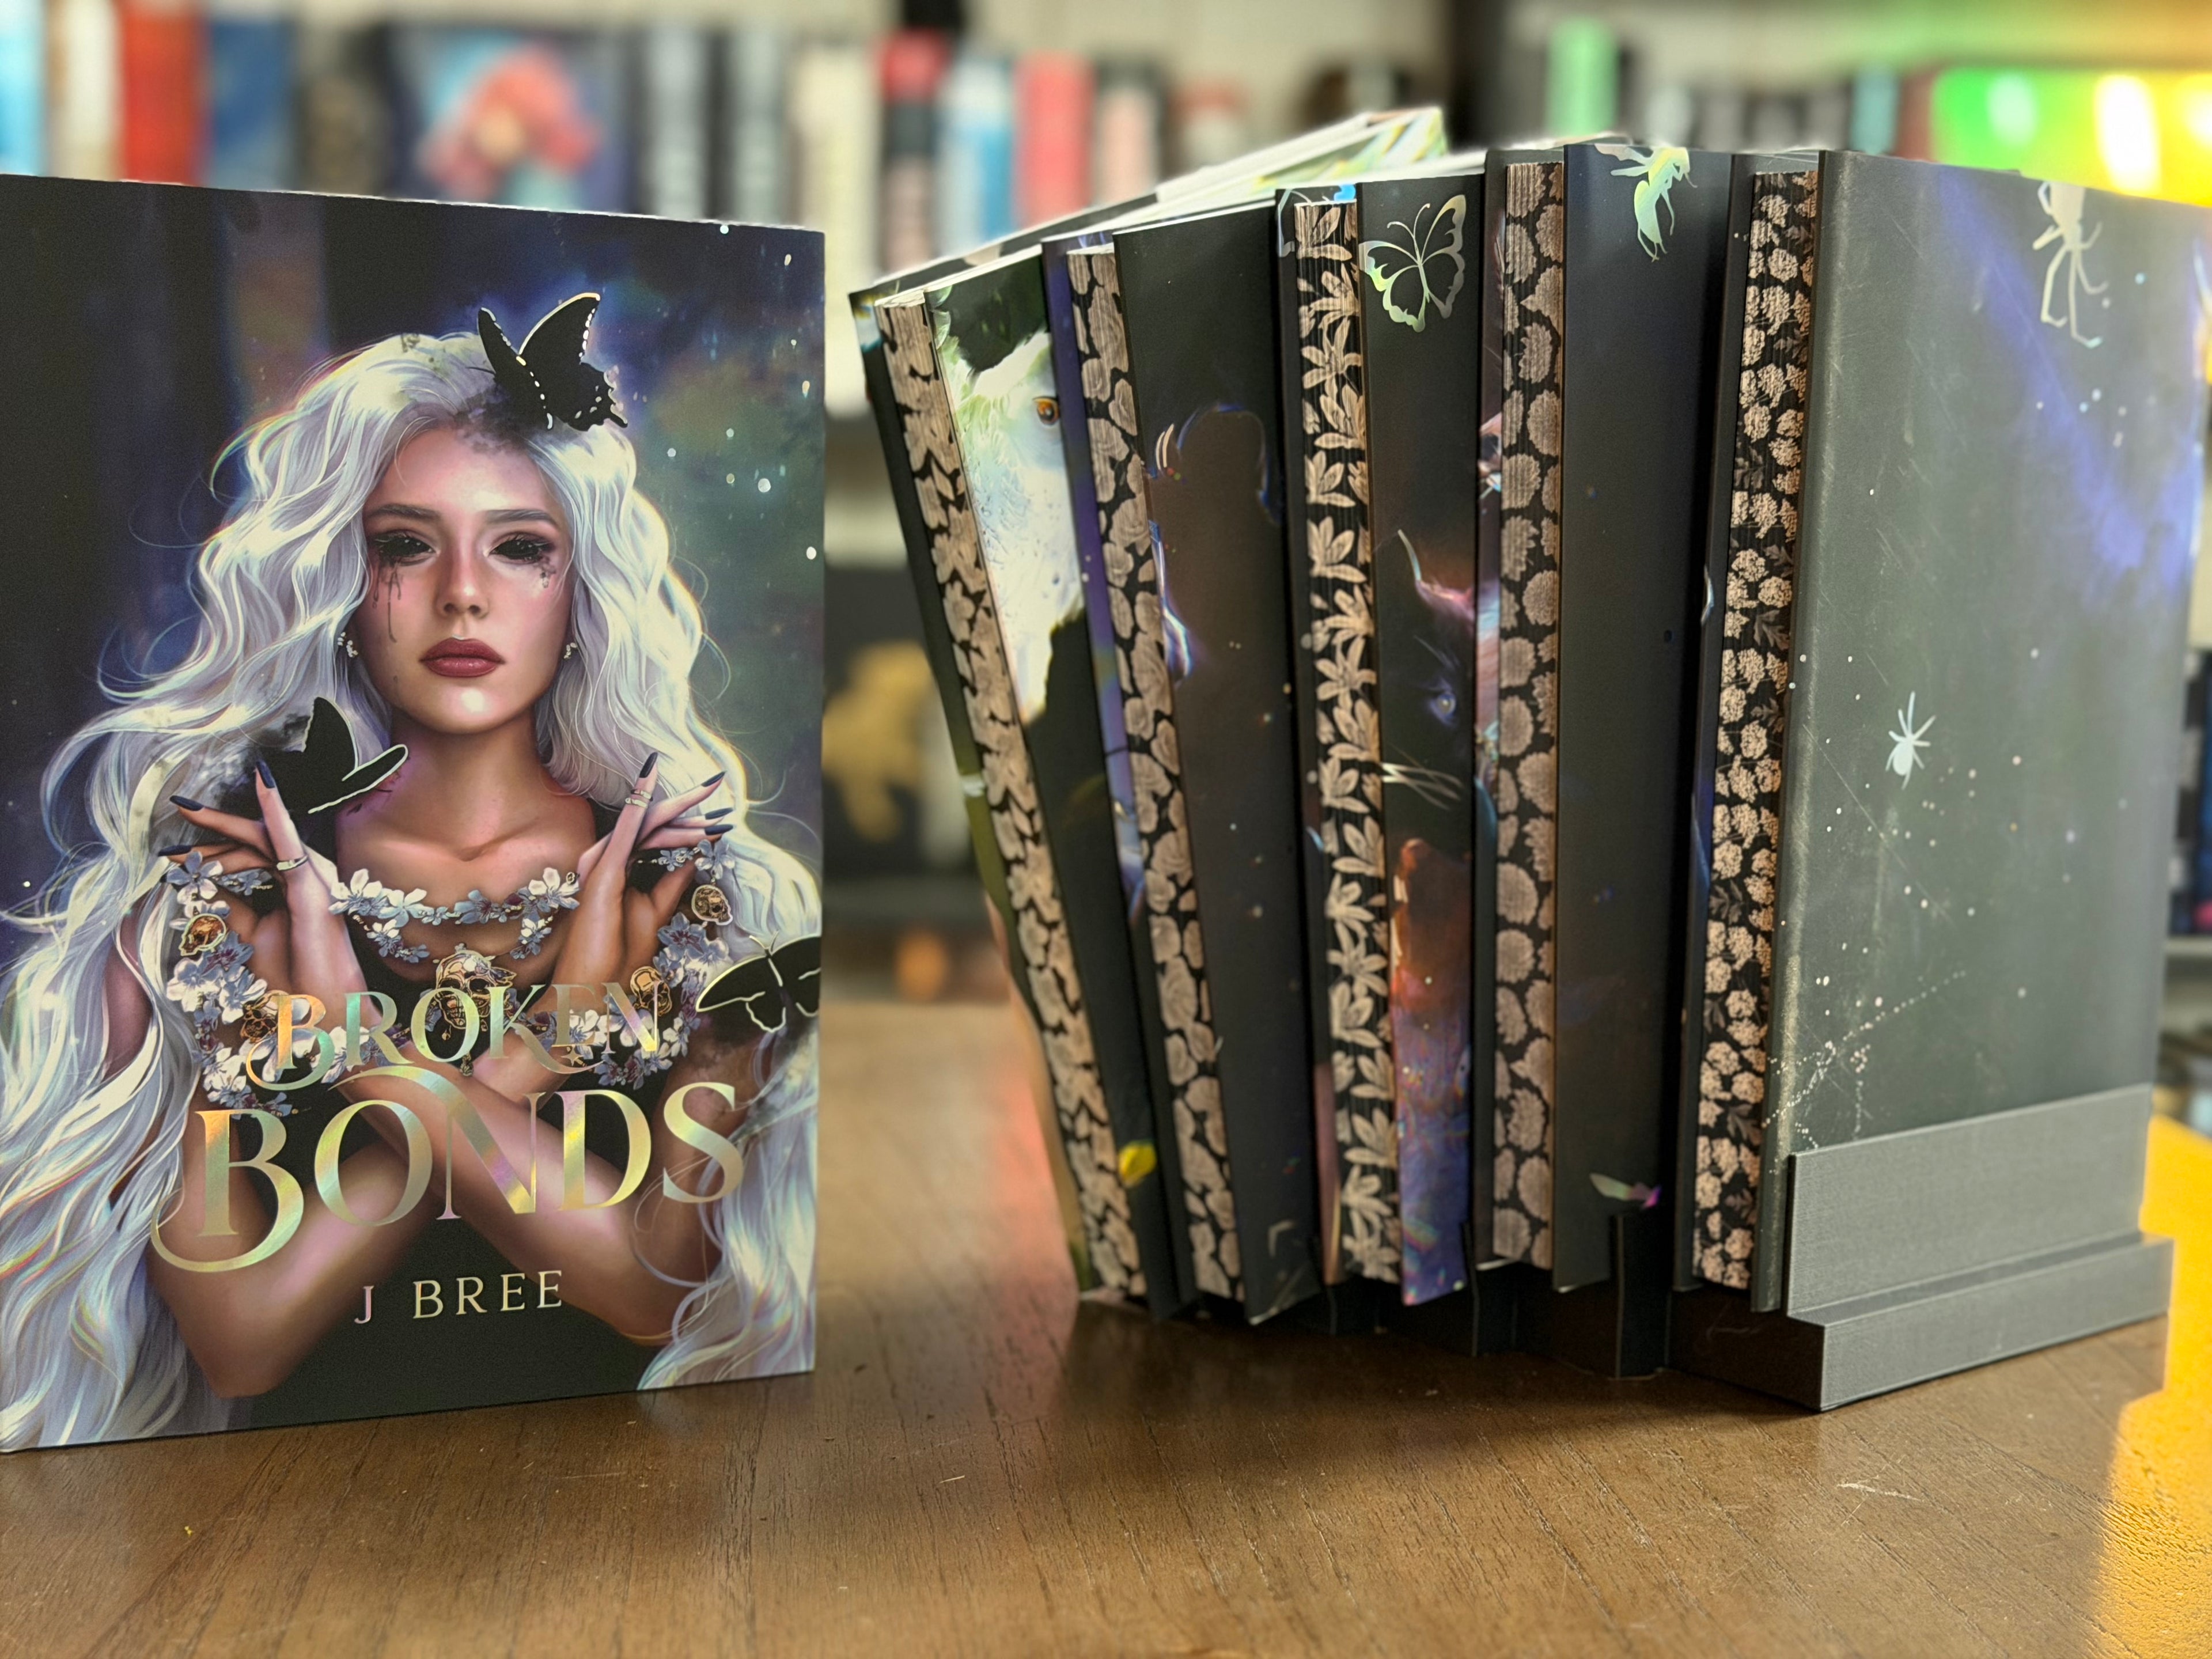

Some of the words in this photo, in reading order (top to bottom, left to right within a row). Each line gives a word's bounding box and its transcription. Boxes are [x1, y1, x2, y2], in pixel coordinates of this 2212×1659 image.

[246, 982, 660, 1091] BROKEN
[150, 1065, 745, 1273] BONDS
[354, 1286, 375, 1324] J
[413, 1271, 562, 1319] BREE
